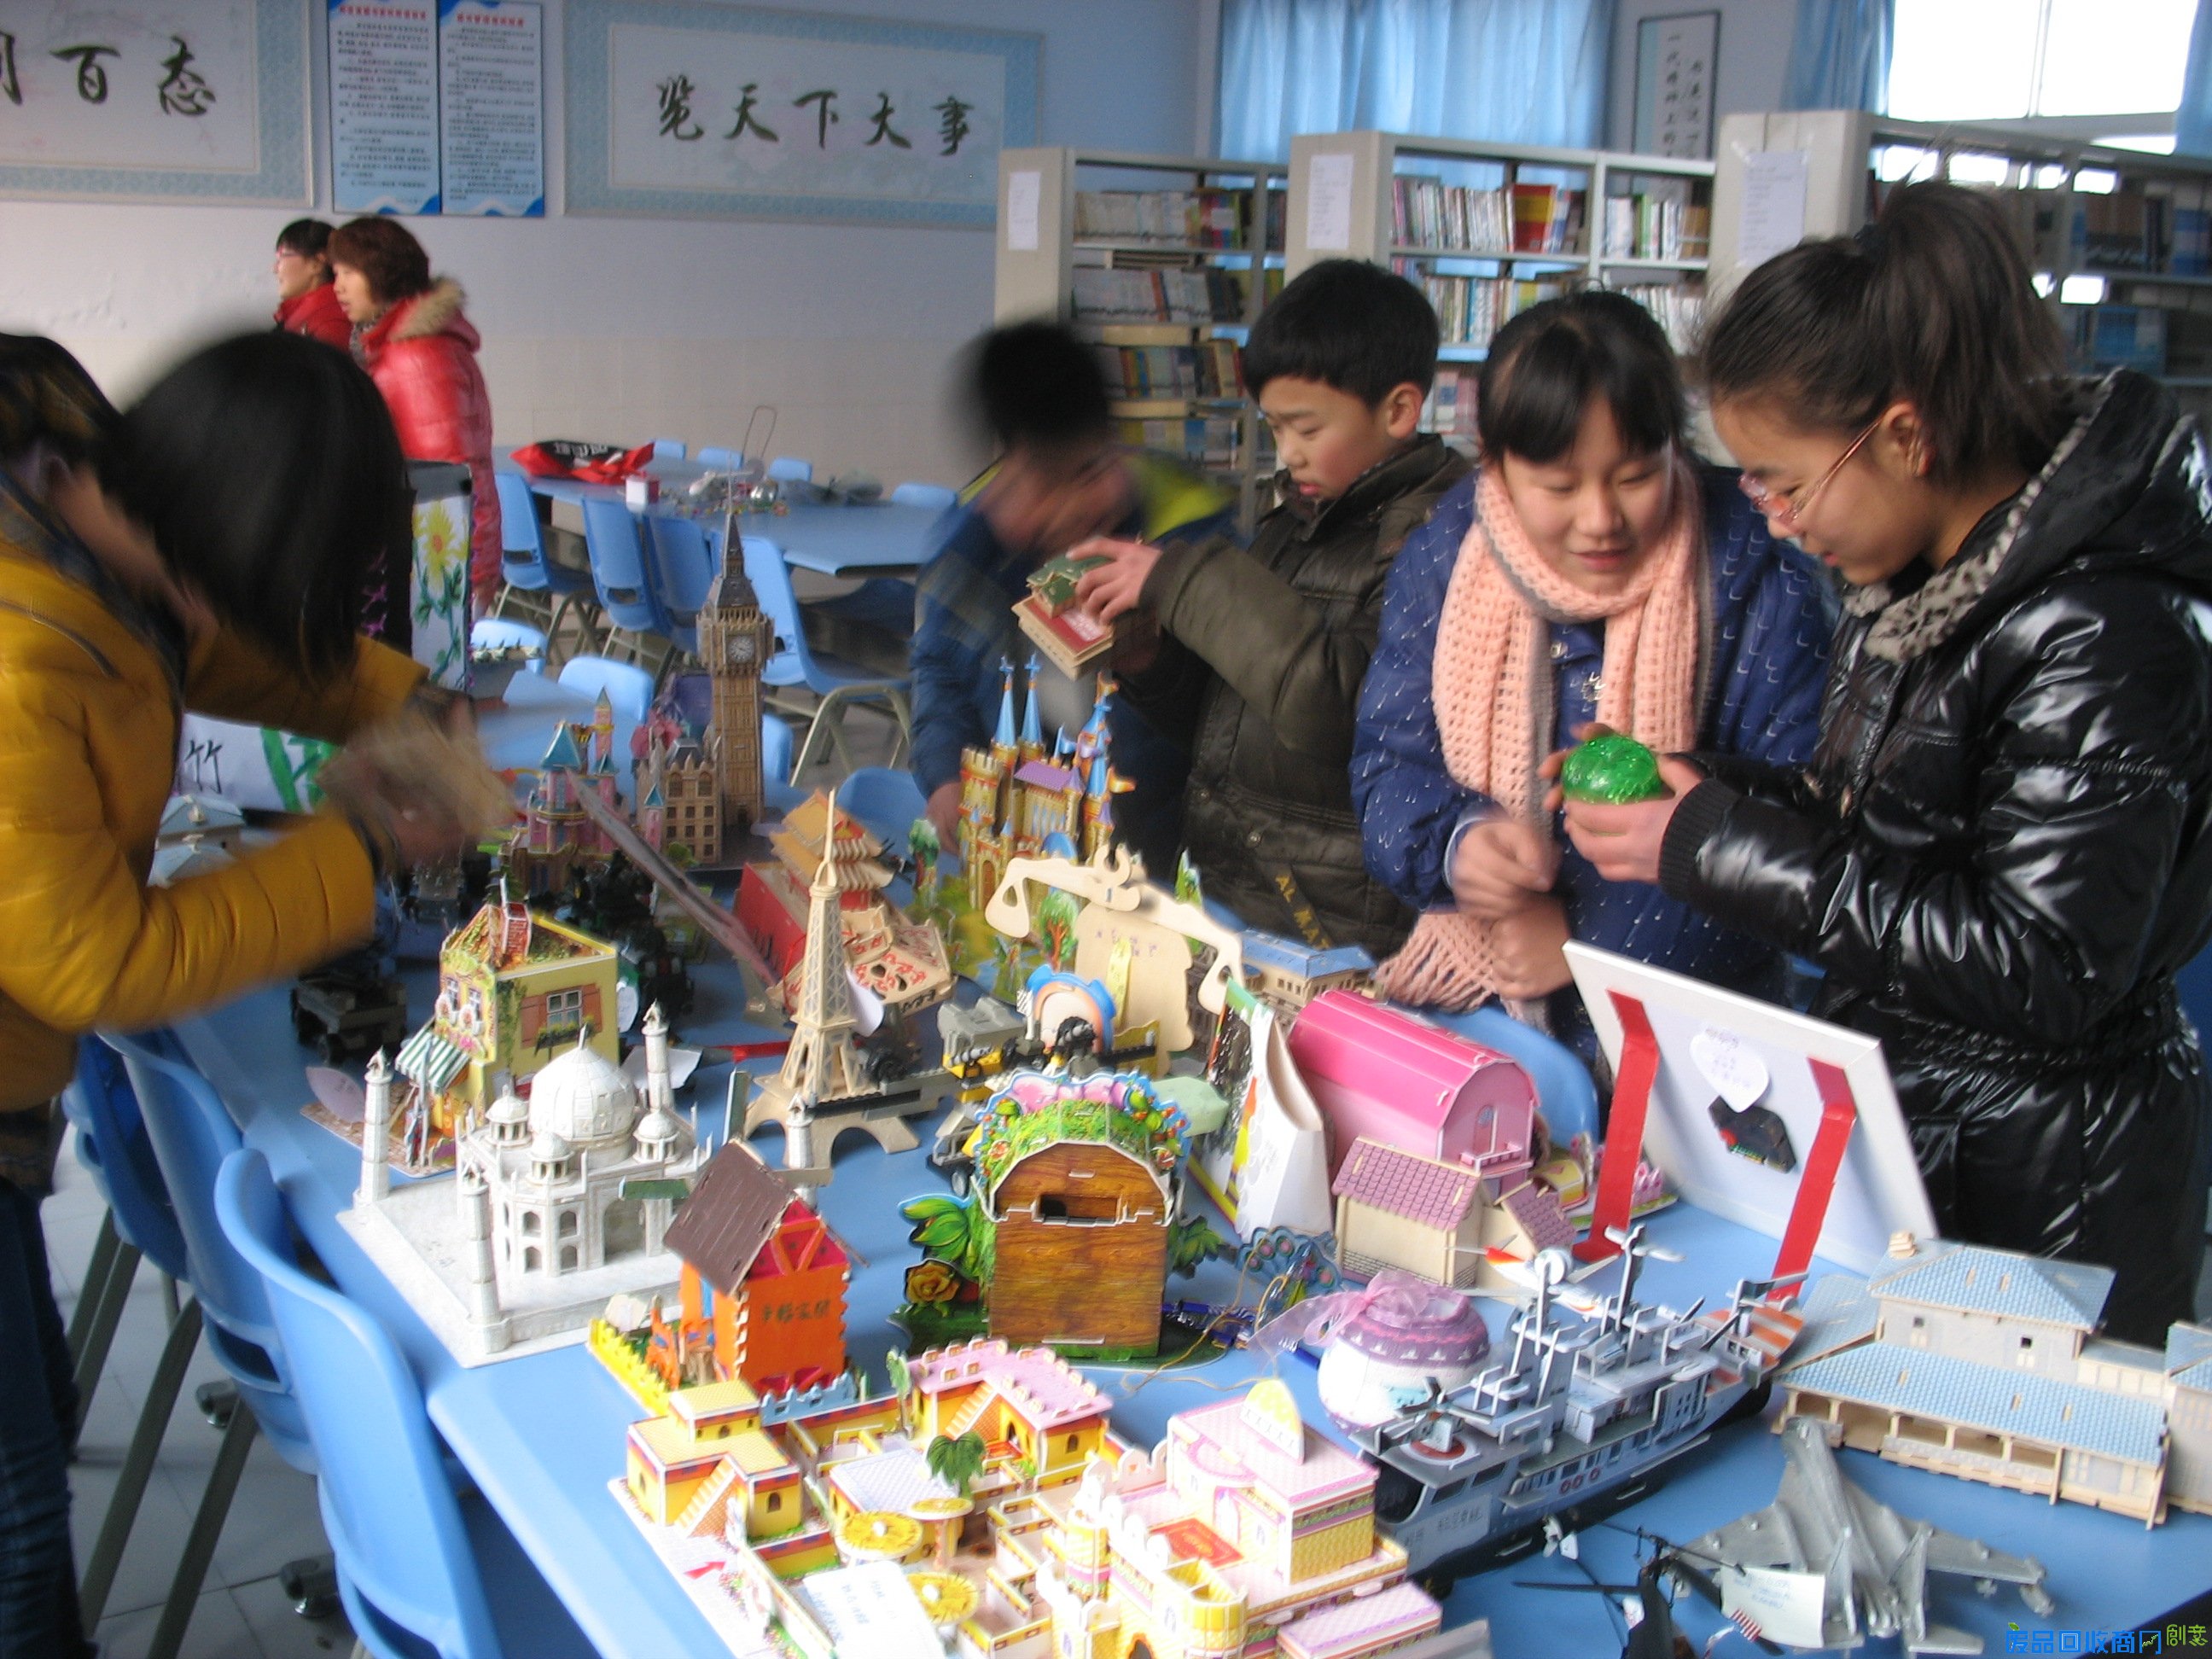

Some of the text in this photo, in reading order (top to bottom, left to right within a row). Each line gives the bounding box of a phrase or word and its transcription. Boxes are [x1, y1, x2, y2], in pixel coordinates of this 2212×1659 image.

[656, 74, 975, 156] 览天下大事
[184, 740, 223, 794] 竹
